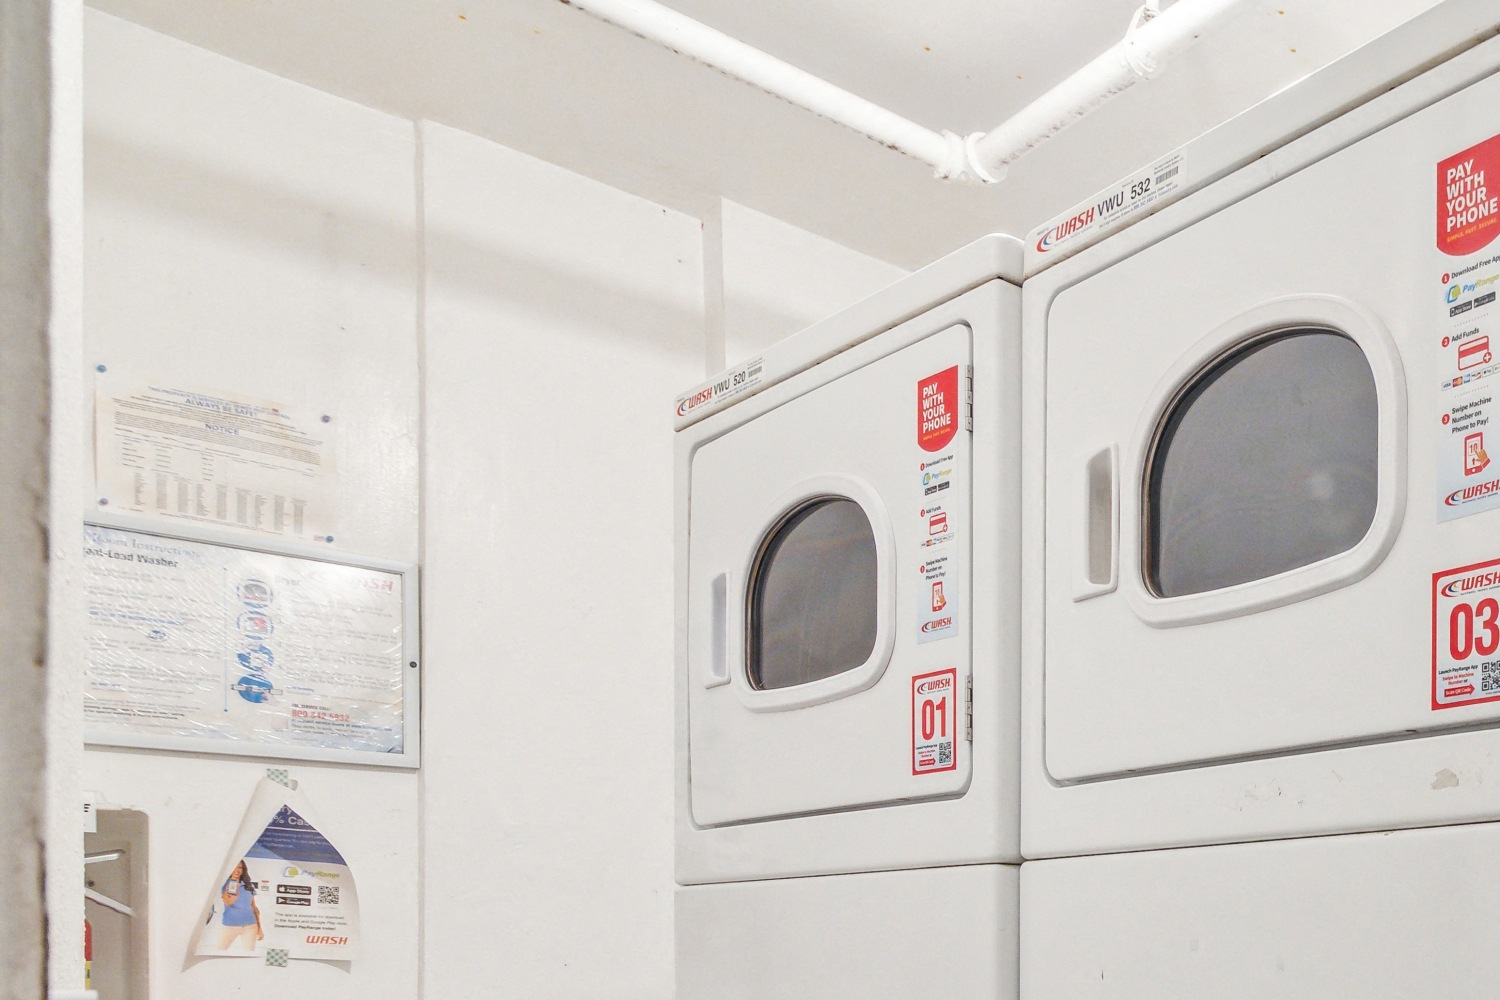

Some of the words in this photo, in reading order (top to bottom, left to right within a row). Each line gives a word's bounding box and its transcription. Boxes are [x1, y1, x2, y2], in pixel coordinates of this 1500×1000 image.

[1446, 158, 1474, 185] PAY
[1446, 171, 1485, 200] WITH
[1055, 206, 1095, 241] WASH
[1098, 191, 1124, 217] VWU
[1130, 177, 1151, 200] 532
[1446, 186, 1487, 216] YOUR
[1446, 197, 1499, 233] PHONE
[1451, 262, 1478, 279] Download
[1479, 258, 1491, 268] Free
[1463, 274, 1500, 293] PayRange
[1451, 332, 1462, 342] Add
[1463, 328, 1480, 339] Funds
[688, 387, 712, 409] WASH
[713, 378, 730, 395] VWU
[733, 371, 746, 386] 520
[923, 382, 938, 398] PAY
[923, 392, 944, 410] WITH
[1452, 405, 1468, 415] Swipe
[1469, 396, 1492, 408] Machine
[923, 404, 945, 422] YOUR
[1452, 413, 1474, 424] Number
[205, 423, 240, 435] NOTICE
[923, 413, 951, 434] PHONE
[1452, 424, 1469, 434] Phone
[1476, 417, 1489, 426] Pay!
[1449, 597, 1500, 661] 03
[922, 696, 946, 740] 01
[302, 869, 340, 879] PayRange
[306, 936, 348, 945] WASH
